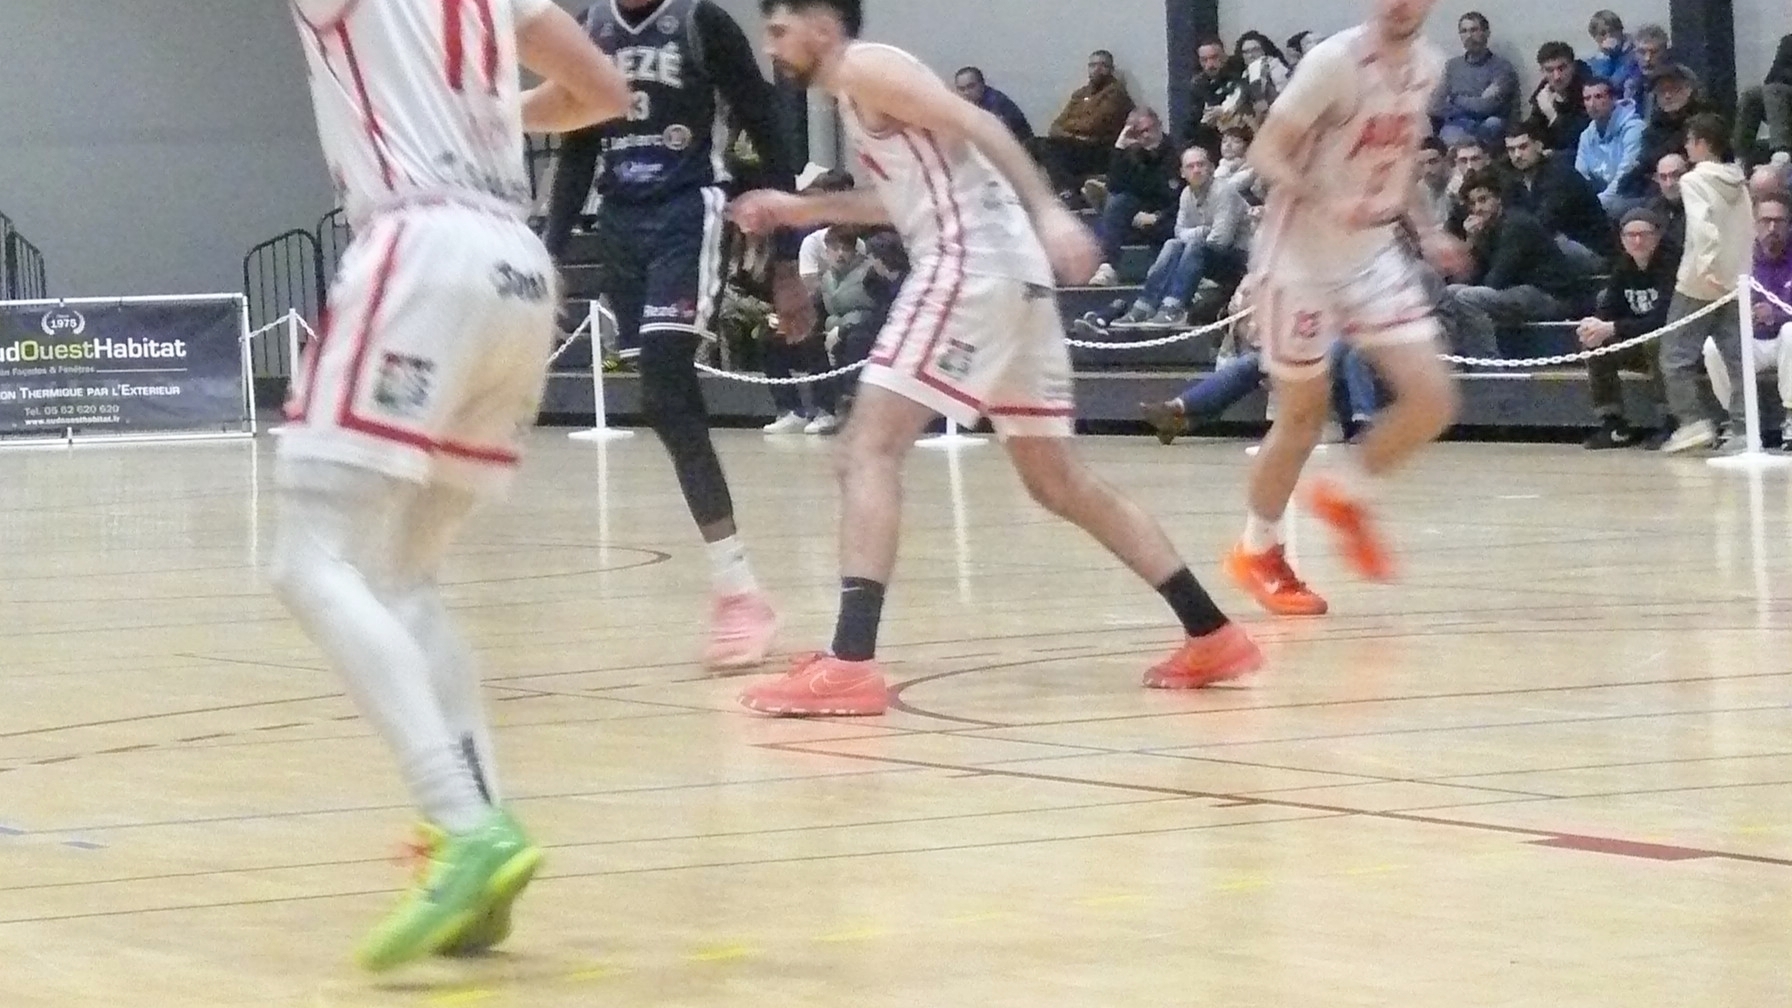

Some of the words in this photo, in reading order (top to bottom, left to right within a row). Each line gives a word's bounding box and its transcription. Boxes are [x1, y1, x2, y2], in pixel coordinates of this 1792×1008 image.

[616, 41, 684, 89] EZÉ
[19, 386, 84, 399] THERMIQUE
[86, 386, 109, 397] PAR
